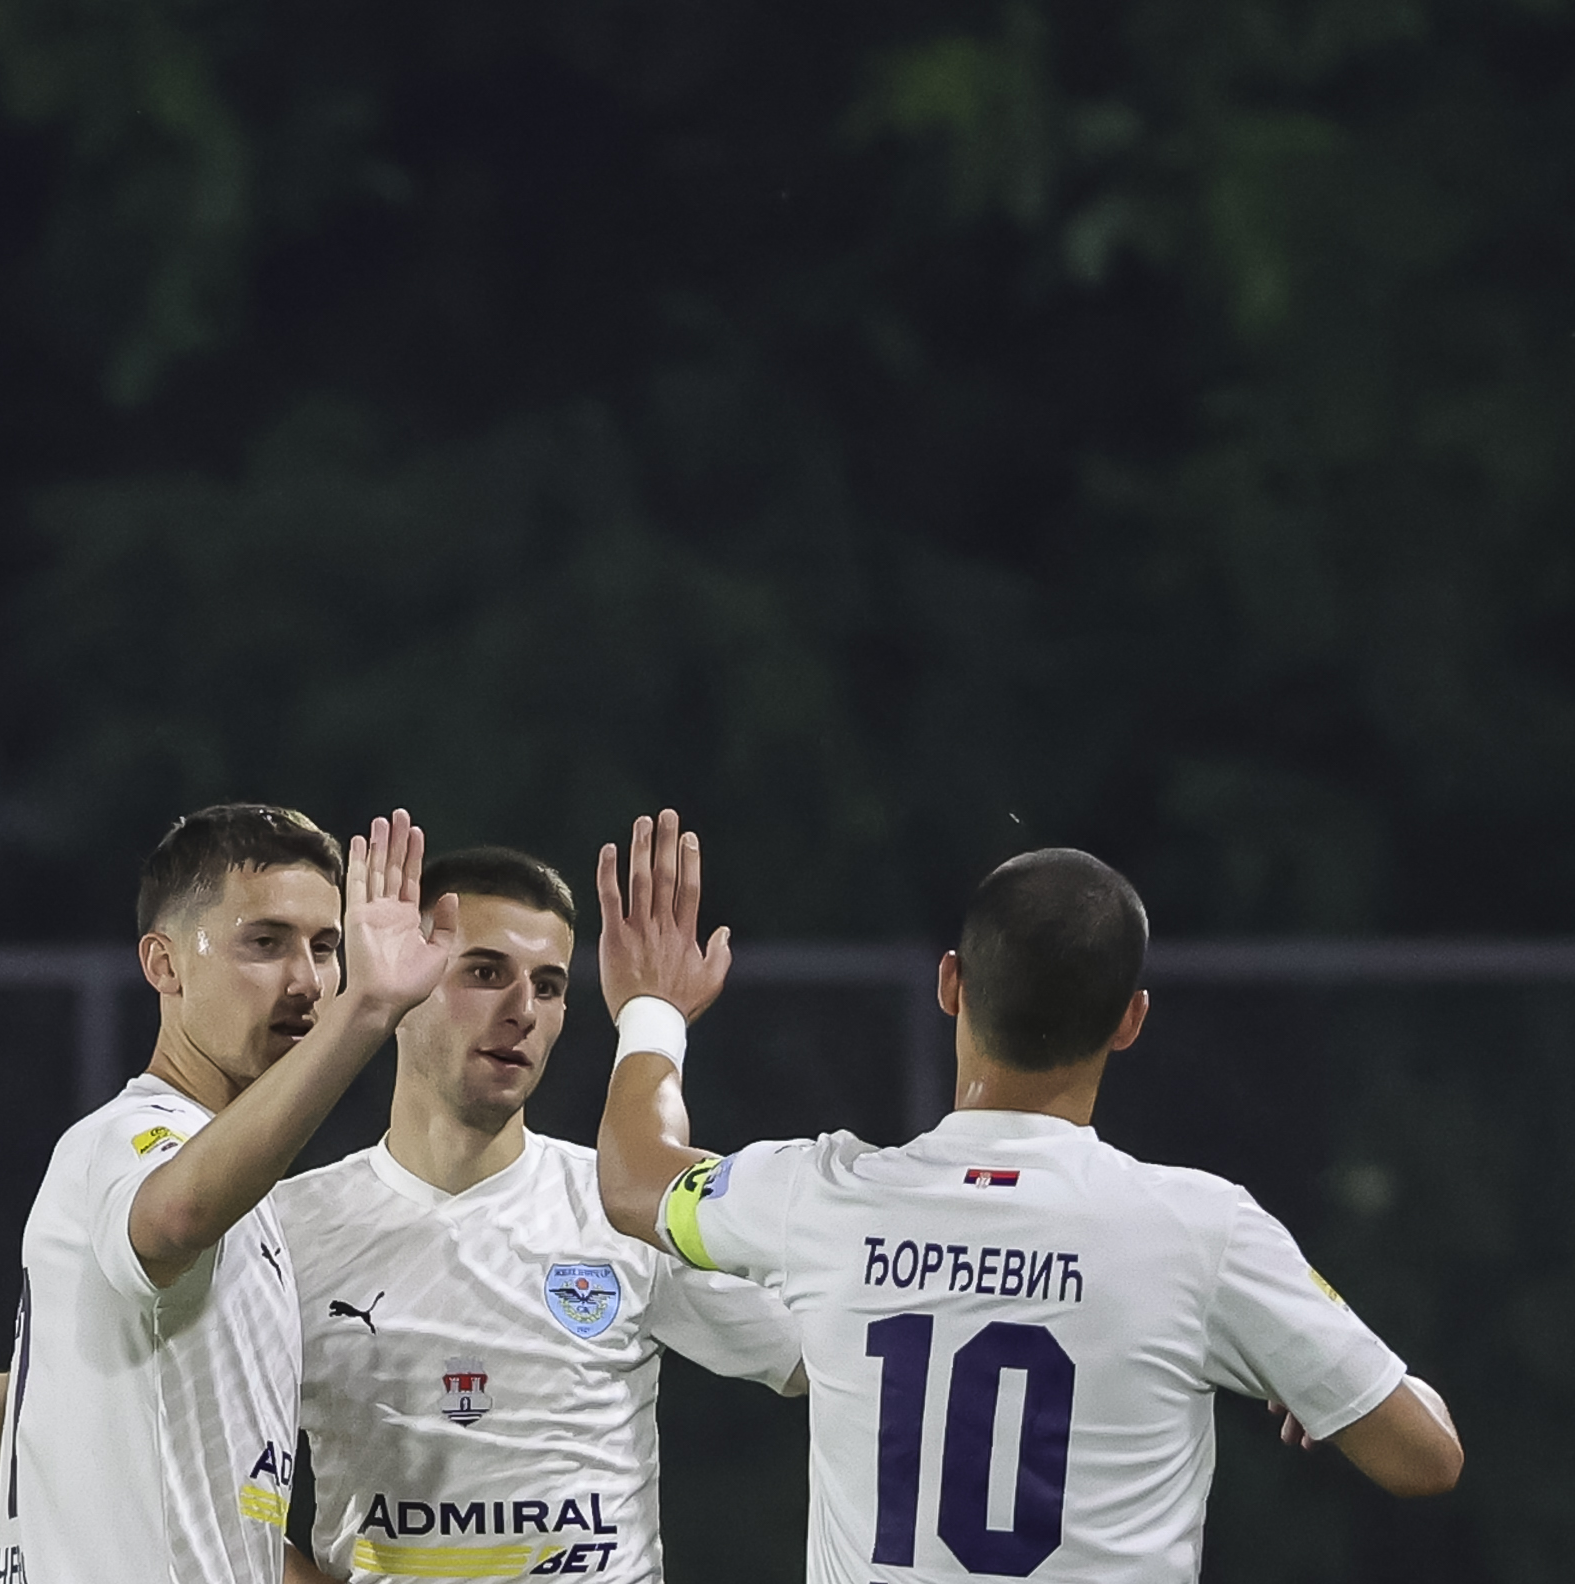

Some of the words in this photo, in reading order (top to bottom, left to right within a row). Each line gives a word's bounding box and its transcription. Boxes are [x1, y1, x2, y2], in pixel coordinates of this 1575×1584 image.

[863, 1236, 1084, 1303] ЂОРЂЕВИЋ
[865, 1312, 1076, 1578] 10
[357, 1493, 618, 1540] ADMIRAL
[529, 1542, 618, 1575] BET
